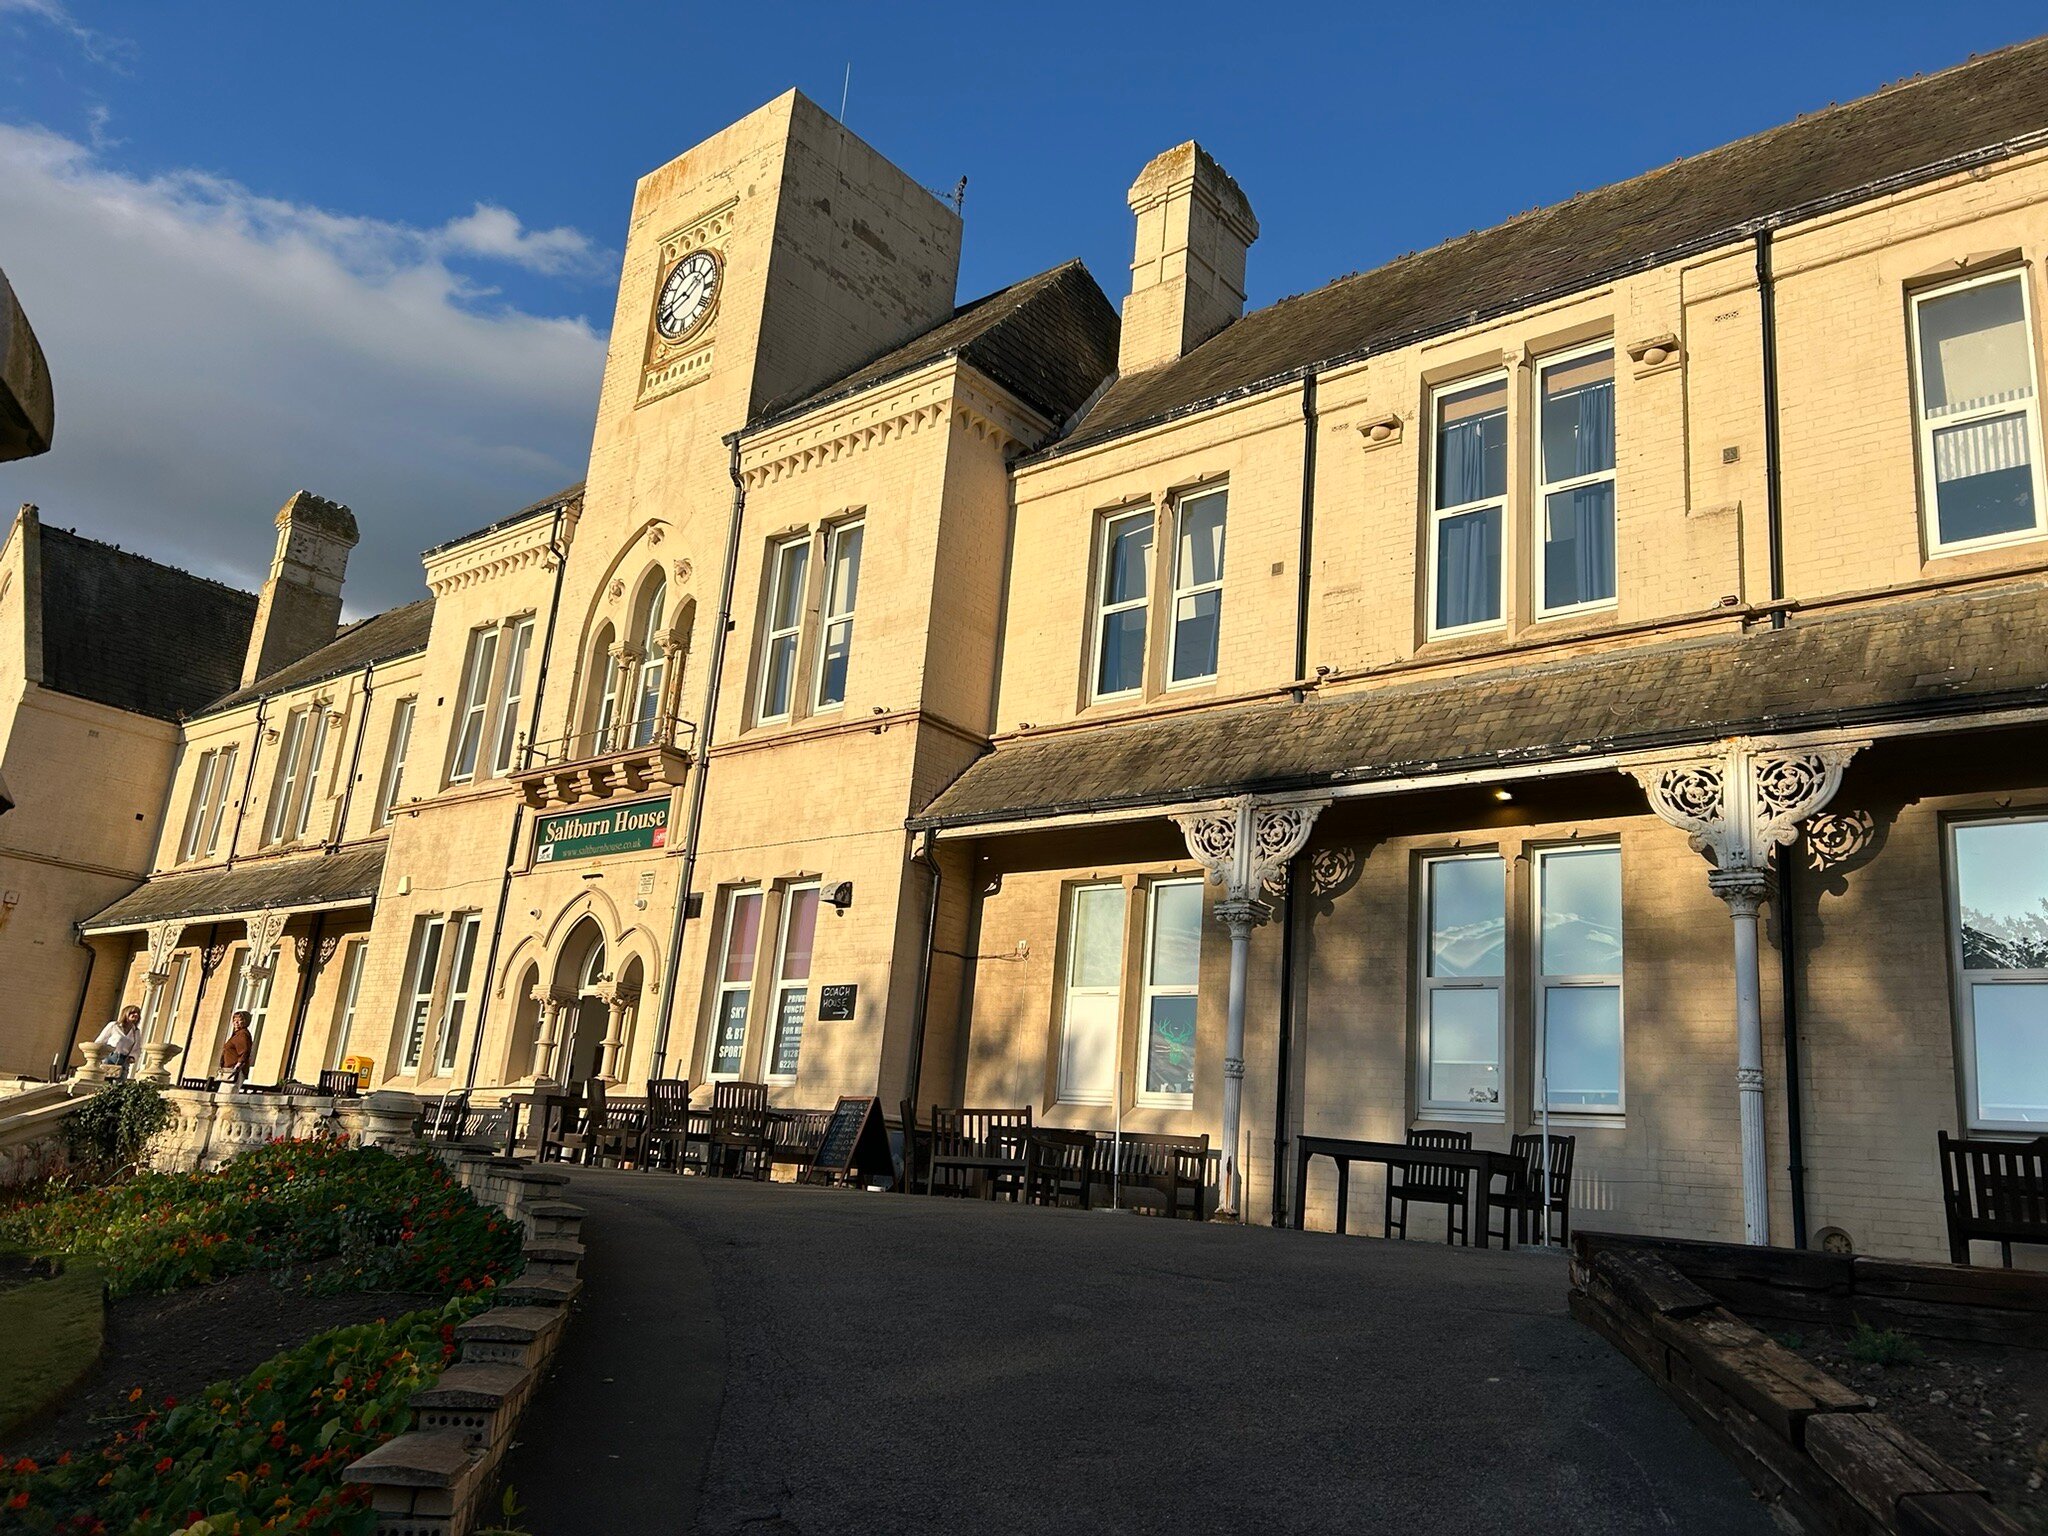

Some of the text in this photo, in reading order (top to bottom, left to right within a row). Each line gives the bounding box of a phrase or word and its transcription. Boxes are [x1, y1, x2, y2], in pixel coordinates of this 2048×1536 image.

[545, 811, 664, 843] Saltburn House
[562, 838, 642, 857] www.saltburnhouse.co.uk
[824, 987, 850, 997] COACH
[823, 998, 848, 1008] HOUSE
[731, 1007, 746, 1019] SKY
[726, 1027, 745, 1040] & BT
[783, 1027, 794, 1035] FOR
